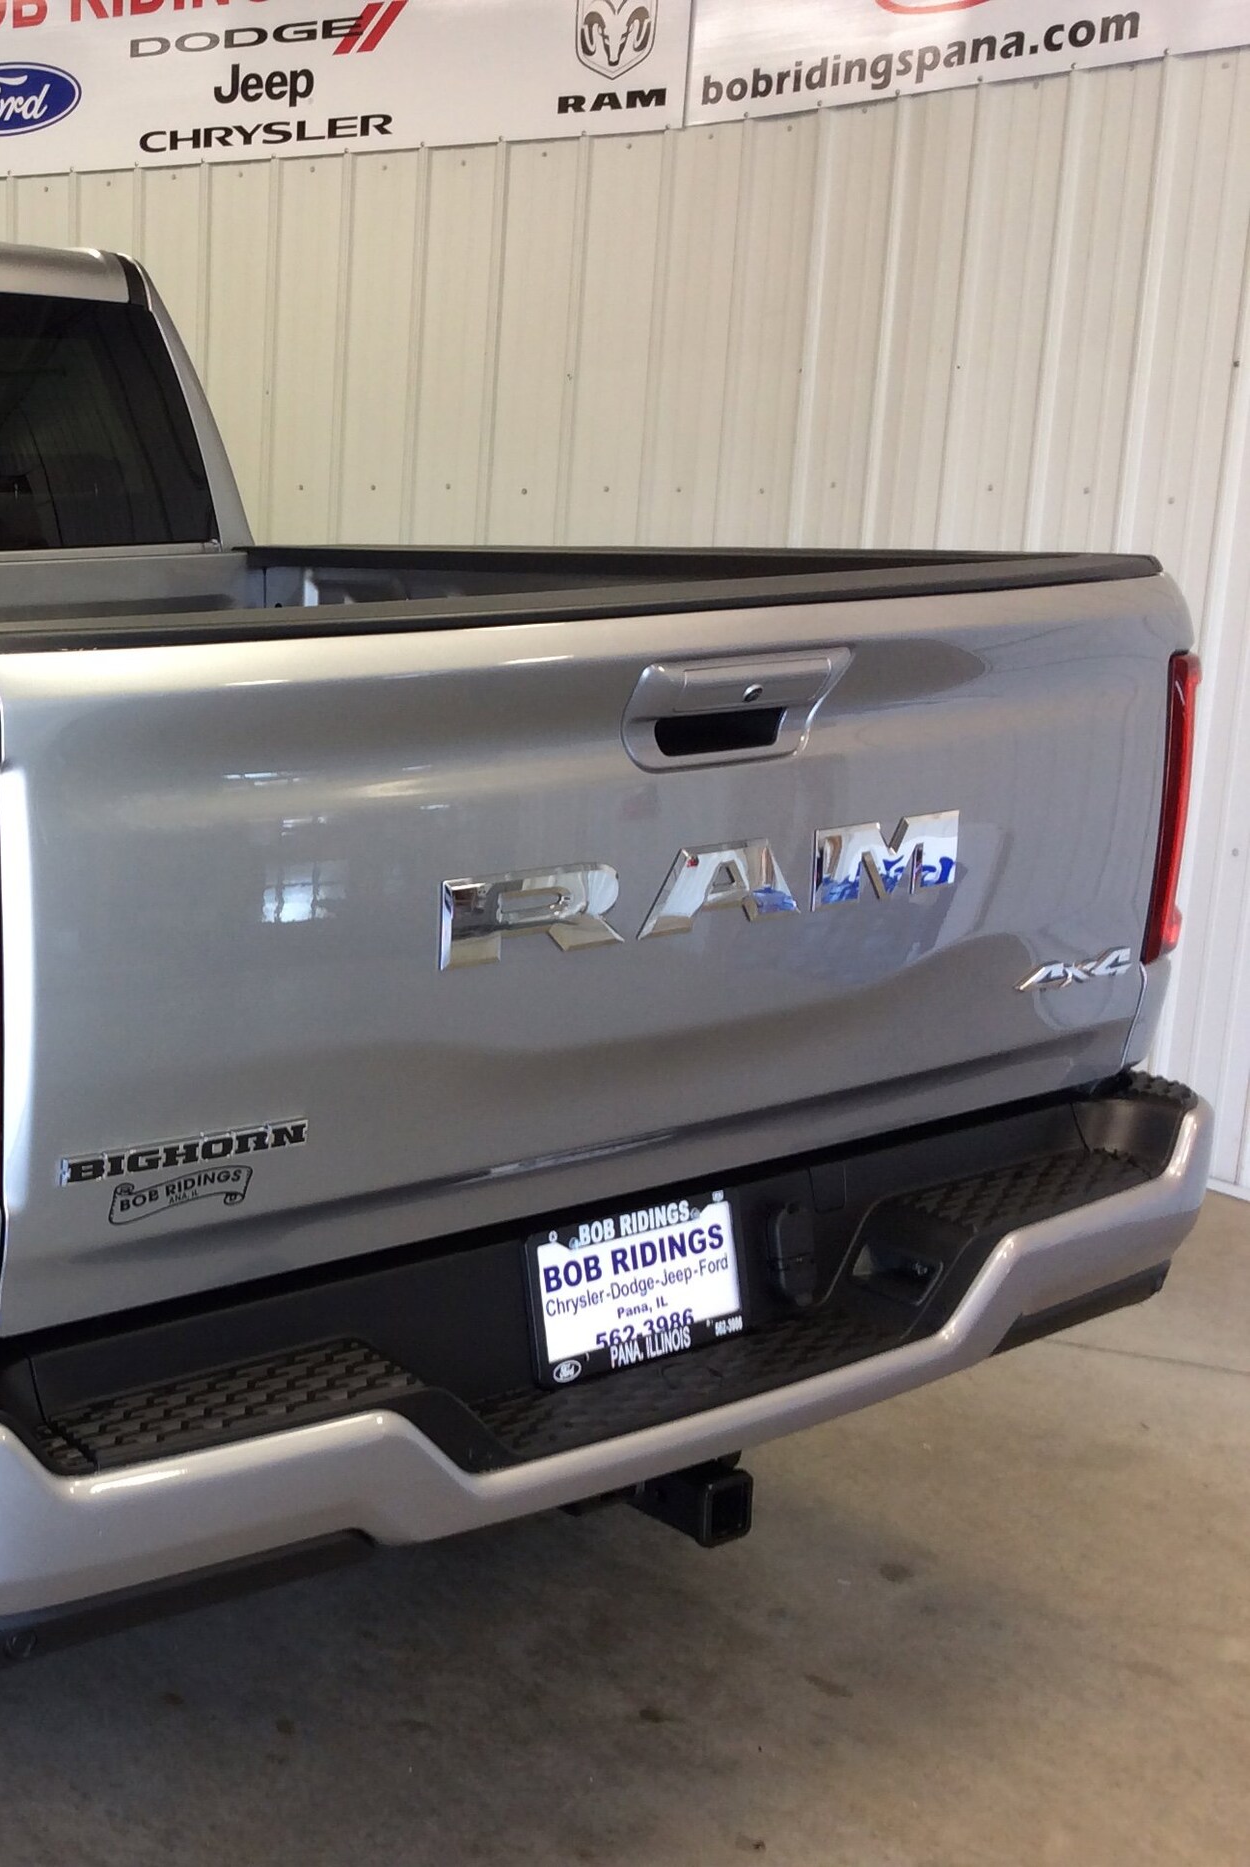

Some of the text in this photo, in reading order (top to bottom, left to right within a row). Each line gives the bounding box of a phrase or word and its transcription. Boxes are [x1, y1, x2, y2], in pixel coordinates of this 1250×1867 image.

[130, 16, 363, 58] DODGE
[702, 10, 1140, 107] bobridingspana.com
[214, 63, 314, 107] Jeep
[557, 88, 667, 114] RAM
[139, 114, 393, 153] CHRYSLER
[438, 810, 960, 971] RAM
[58, 1116, 308, 1187] BIGHORN
[119, 1168, 242, 1212] BOB RIDINGS
[578, 1199, 691, 1247] BOB RIDINGS
[543, 1223, 725, 1294] BOB RIDINGS
[617, 1295, 669, 1320] Pana, IL
[645, 1325, 692, 1360] ILLINOIS
